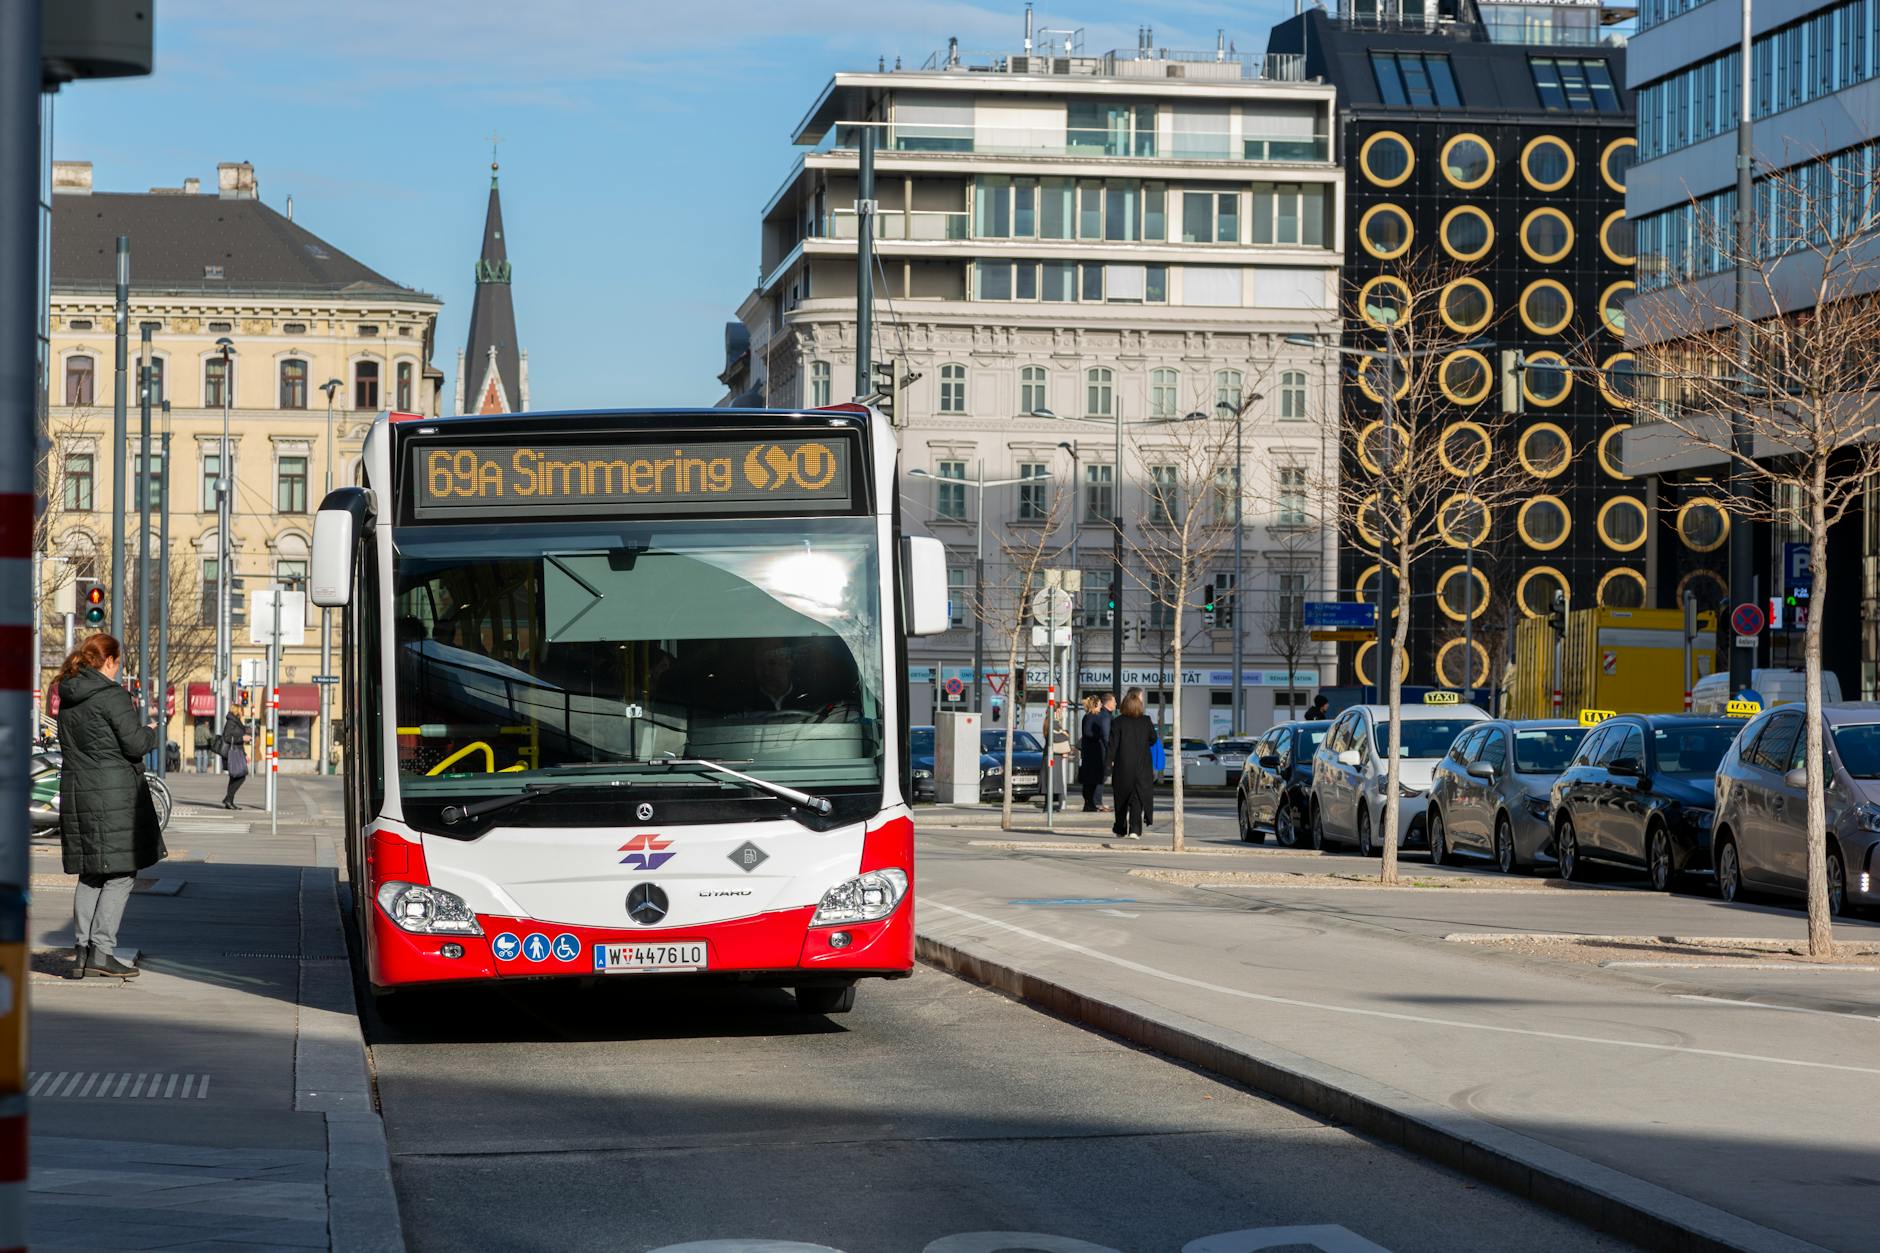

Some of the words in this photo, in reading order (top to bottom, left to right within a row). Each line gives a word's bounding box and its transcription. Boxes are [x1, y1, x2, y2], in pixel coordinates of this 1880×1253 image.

[512, 447, 732, 496] Simmering
[1122, 670, 1138, 682] ÜR
[1428, 693, 1456, 702] TAXI
[1731, 703, 1757, 711] TAXI
[609, 948, 621, 965] W
